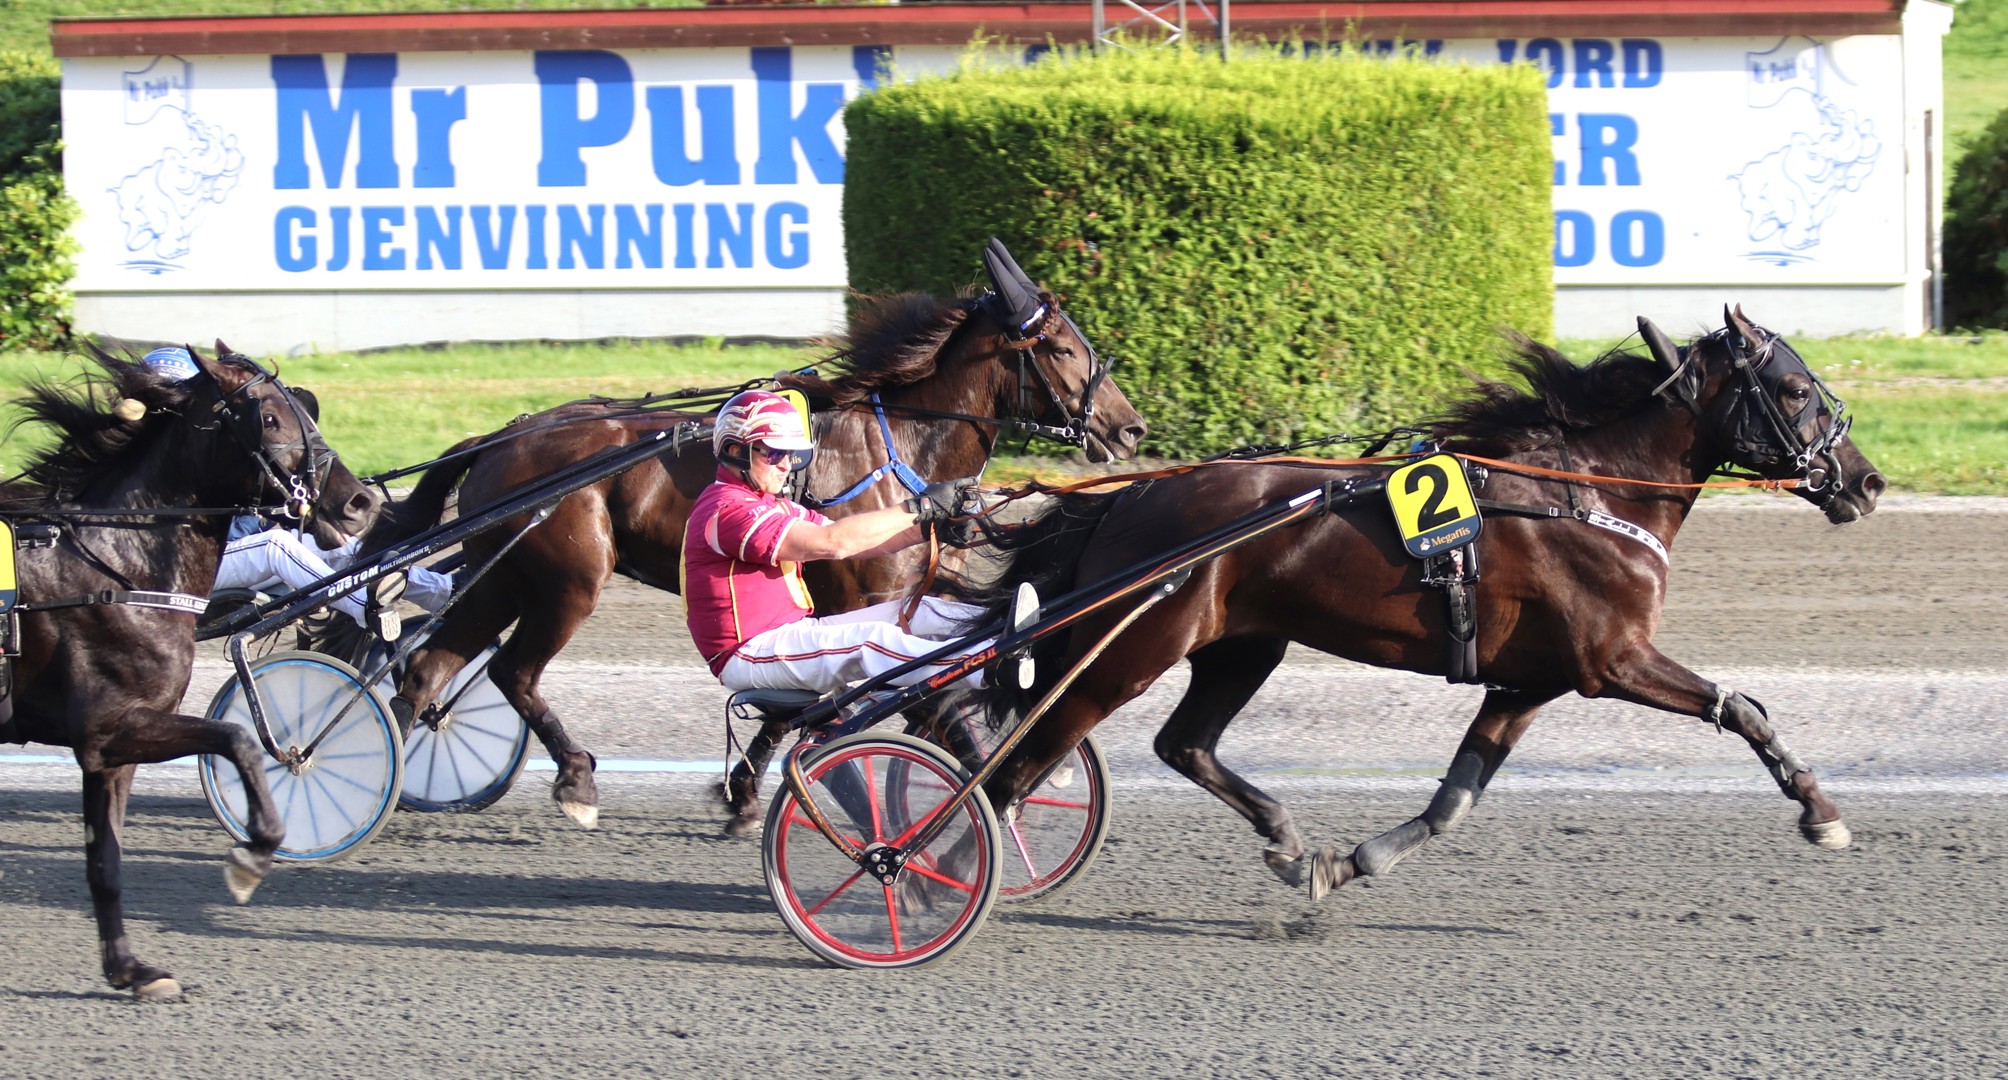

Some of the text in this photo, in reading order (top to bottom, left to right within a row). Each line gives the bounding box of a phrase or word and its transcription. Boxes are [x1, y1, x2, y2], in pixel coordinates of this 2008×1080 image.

[271, 45, 893, 190] Mr Puk
[273, 202, 811, 273] GJENVINNING
[1404, 463, 1462, 533] 2
[1431, 526, 1471, 547] Megaflis
[327, 564, 380, 598] CUSTOM
[170, 596, 194, 607] STALL
[927, 666, 964, 688] Custom
[963, 651, 987, 672] FCS
